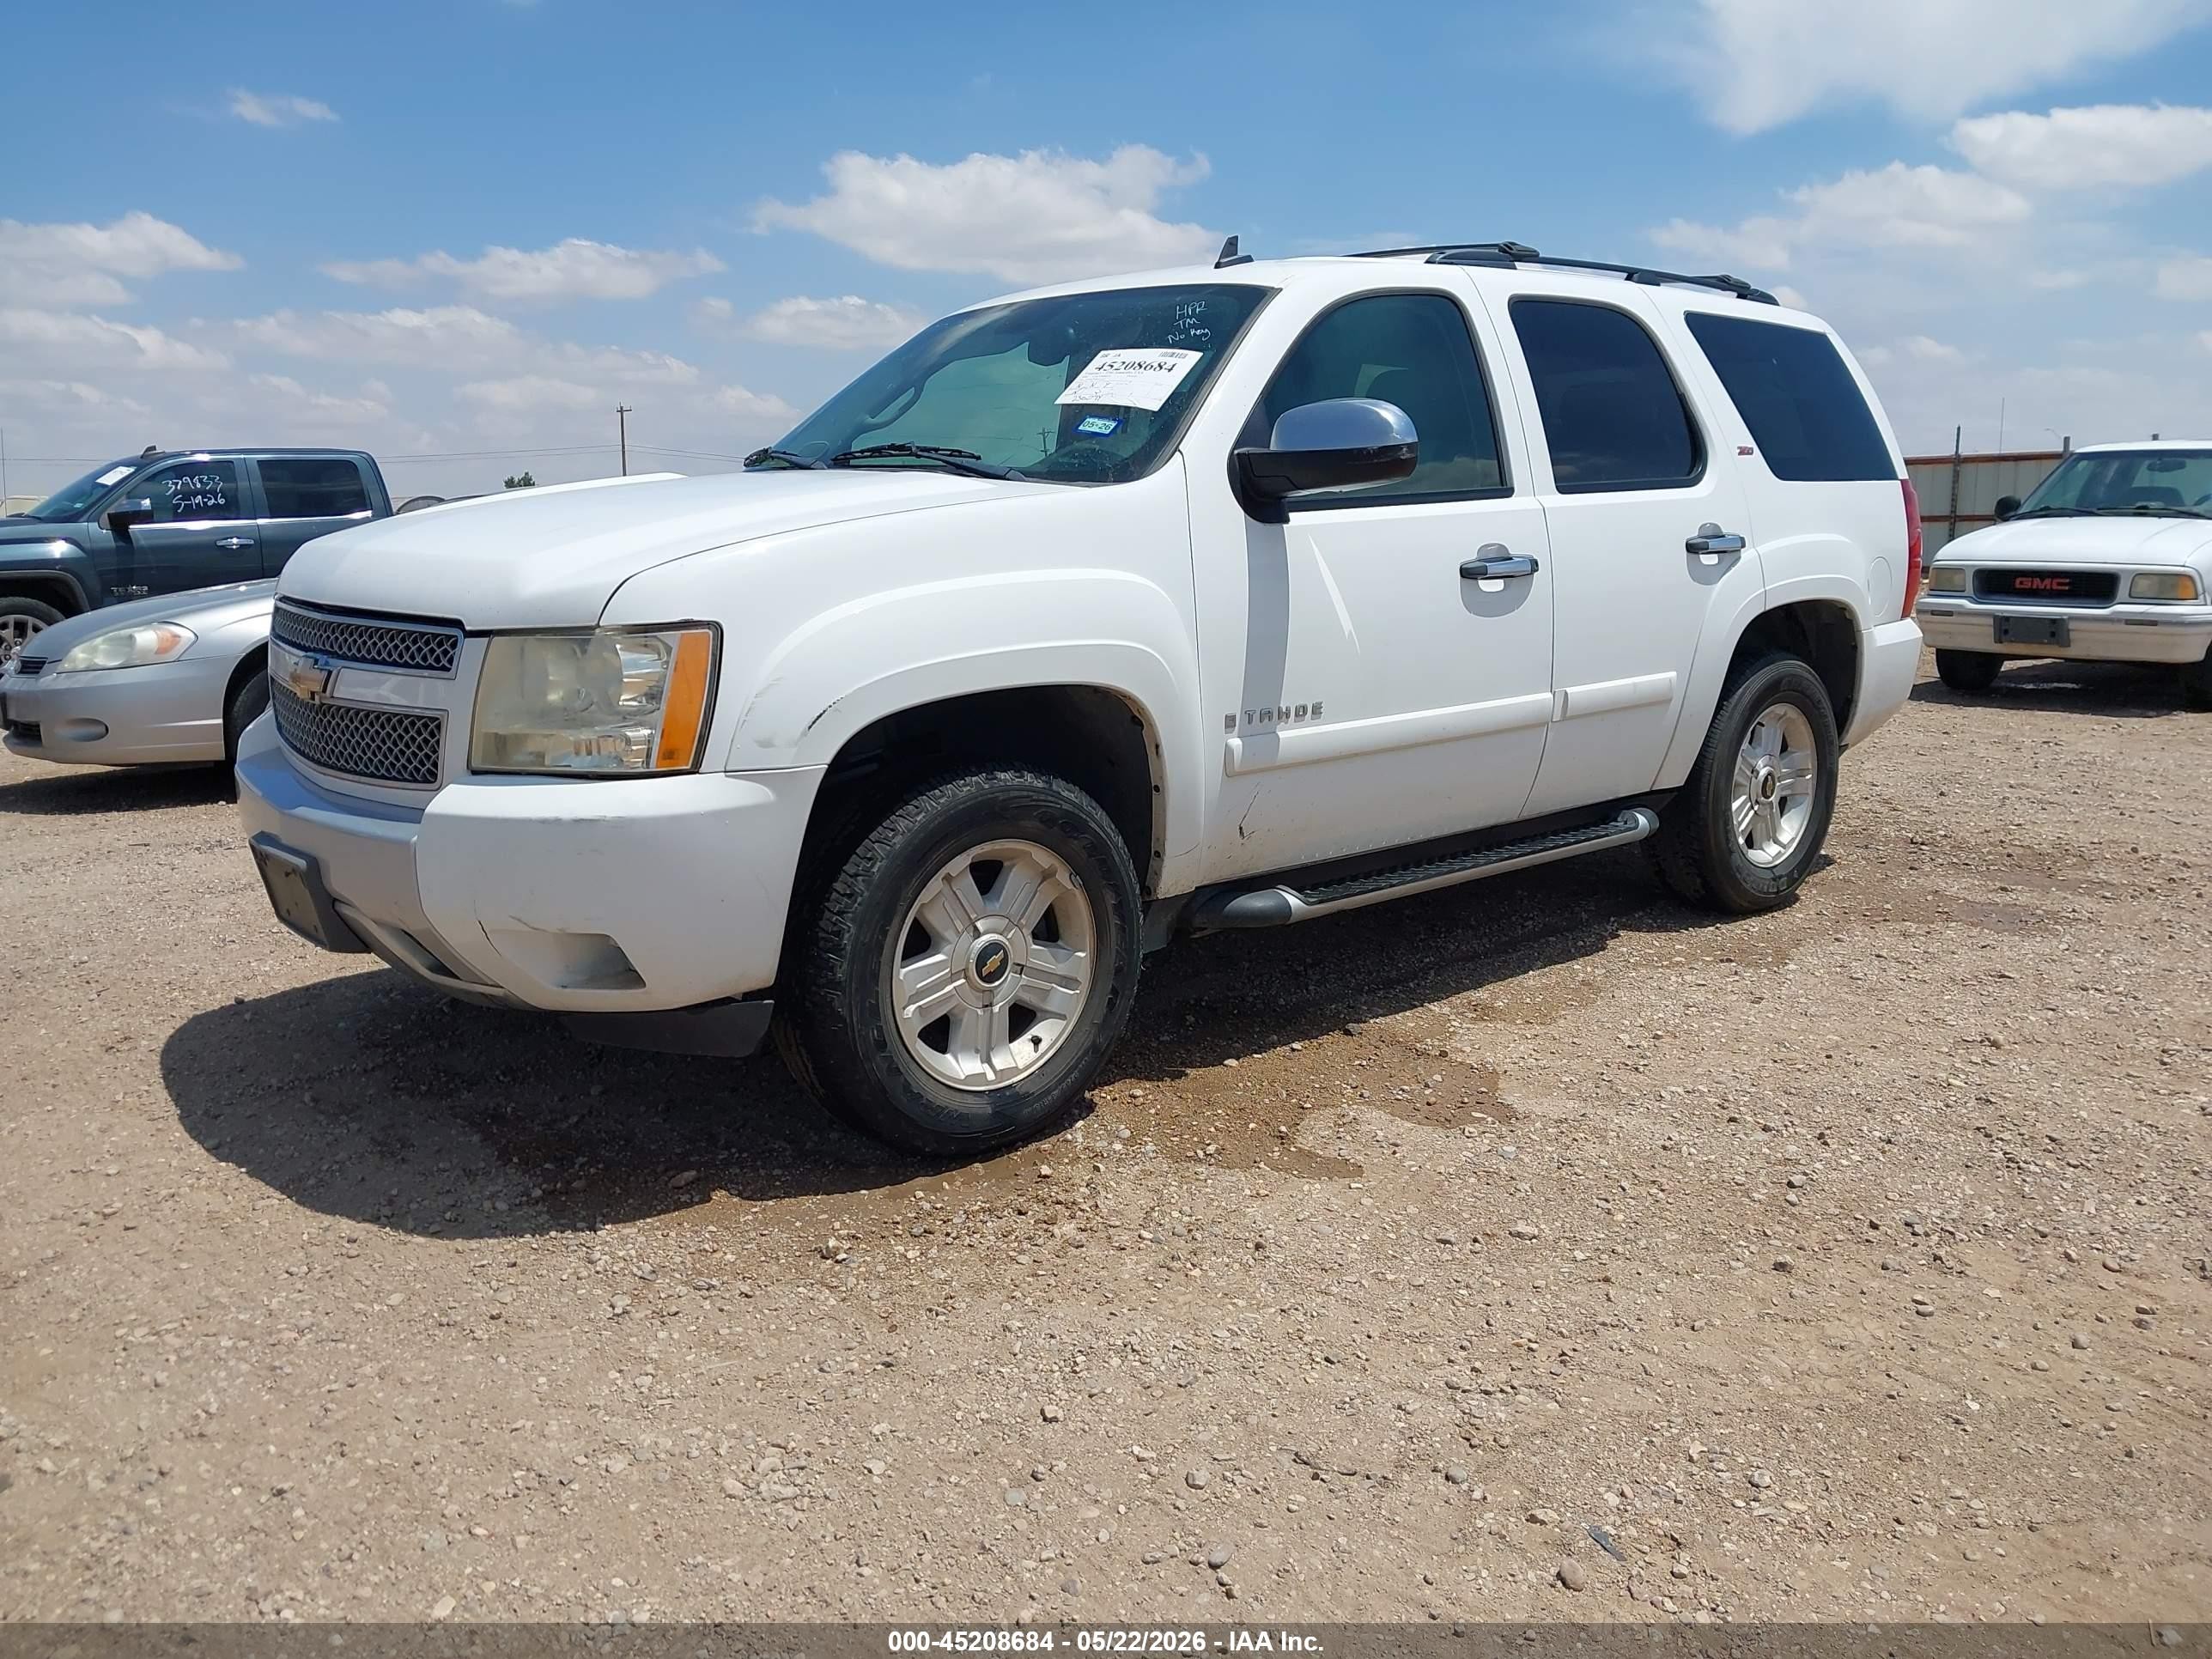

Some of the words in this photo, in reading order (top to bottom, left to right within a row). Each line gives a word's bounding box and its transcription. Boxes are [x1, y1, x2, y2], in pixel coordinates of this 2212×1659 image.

[1168, 331, 1185, 343] No
[1095, 359, 1177, 373] 45208684
[161, 475, 223, 495] 379833
[2014, 577, 2070, 590] GMC
[1244, 701, 1324, 725] TAHOE
